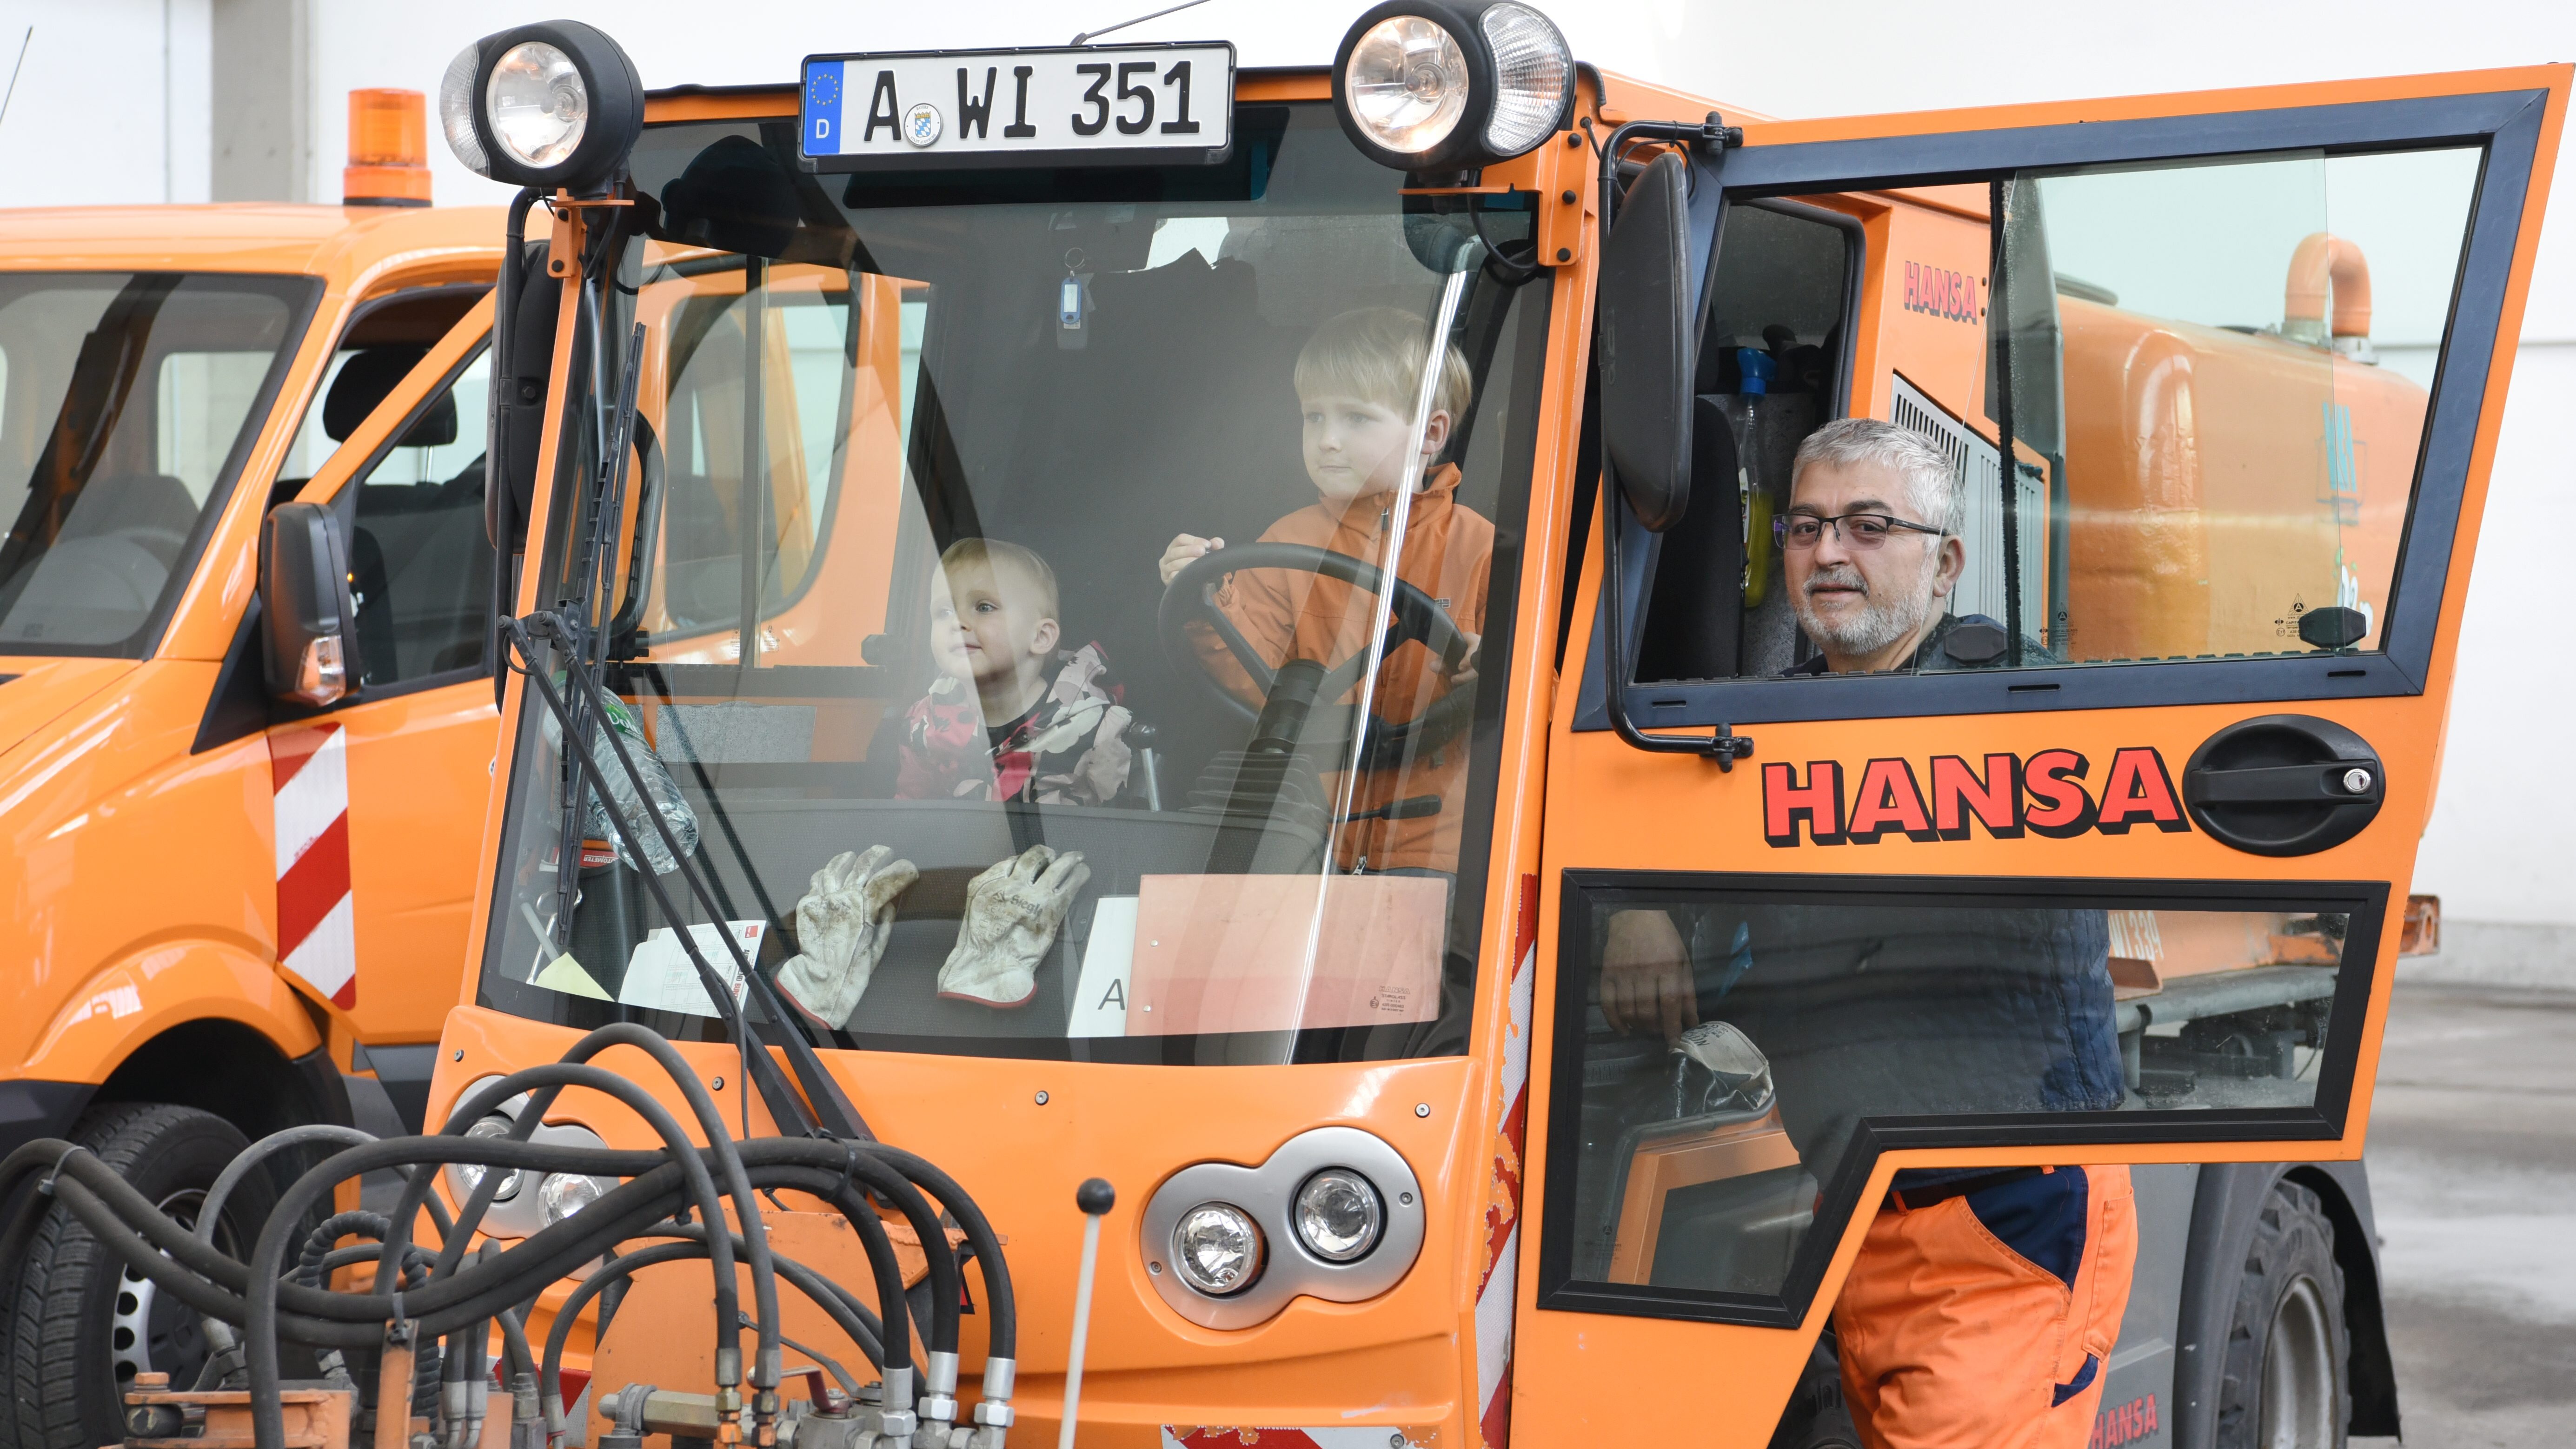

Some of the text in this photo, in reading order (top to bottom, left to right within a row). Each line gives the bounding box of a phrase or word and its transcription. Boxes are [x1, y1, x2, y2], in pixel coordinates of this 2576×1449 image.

[815, 119, 830, 139] D
[863, 60, 1201, 142] A WI 351
[1904, 260, 1977, 325] HANSA
[1761, 747, 2192, 848] HANSA
[1097, 978, 1126, 1011] A
[2091, 1393, 2158, 1449] HANSA
